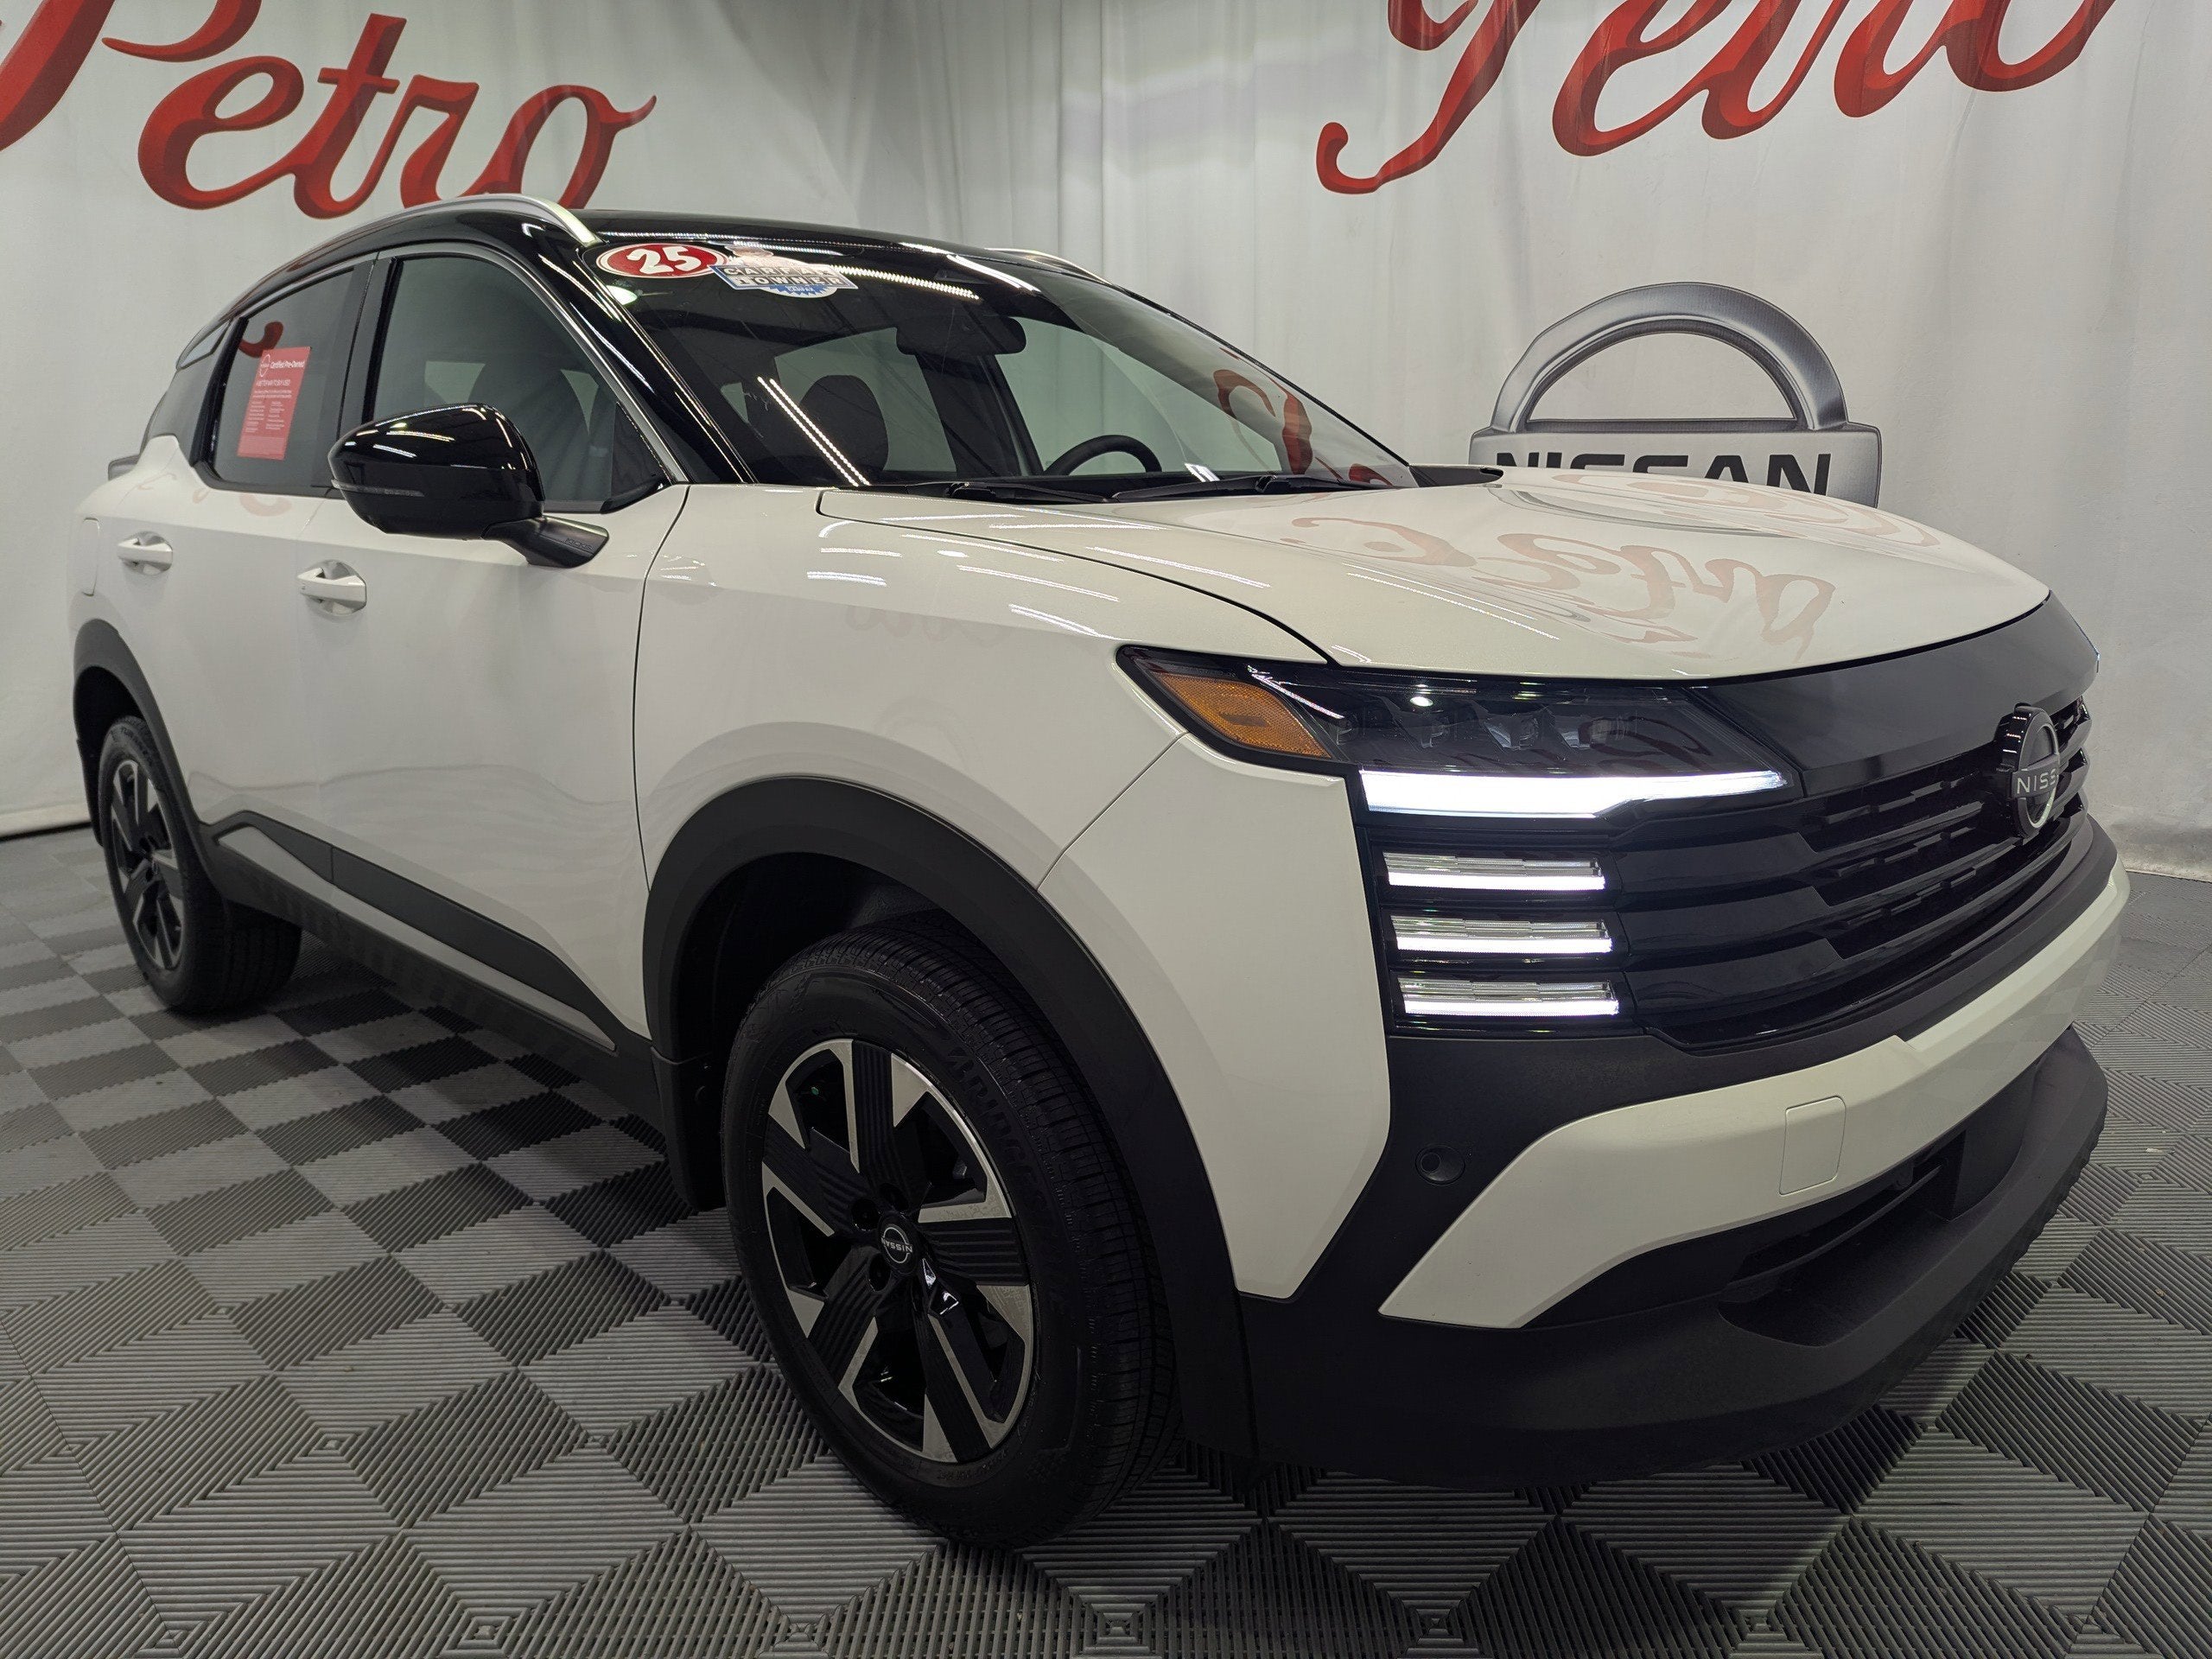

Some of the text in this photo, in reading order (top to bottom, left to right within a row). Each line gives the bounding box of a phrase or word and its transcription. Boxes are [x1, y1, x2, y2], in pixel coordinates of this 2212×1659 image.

[626, 245, 702, 275] 25
[722, 266, 834, 276] CARFA
[753, 276, 845, 286] OWNER
[2016, 767, 2058, 794] NISS
[880, 1236, 913, 1254] NISSAN
